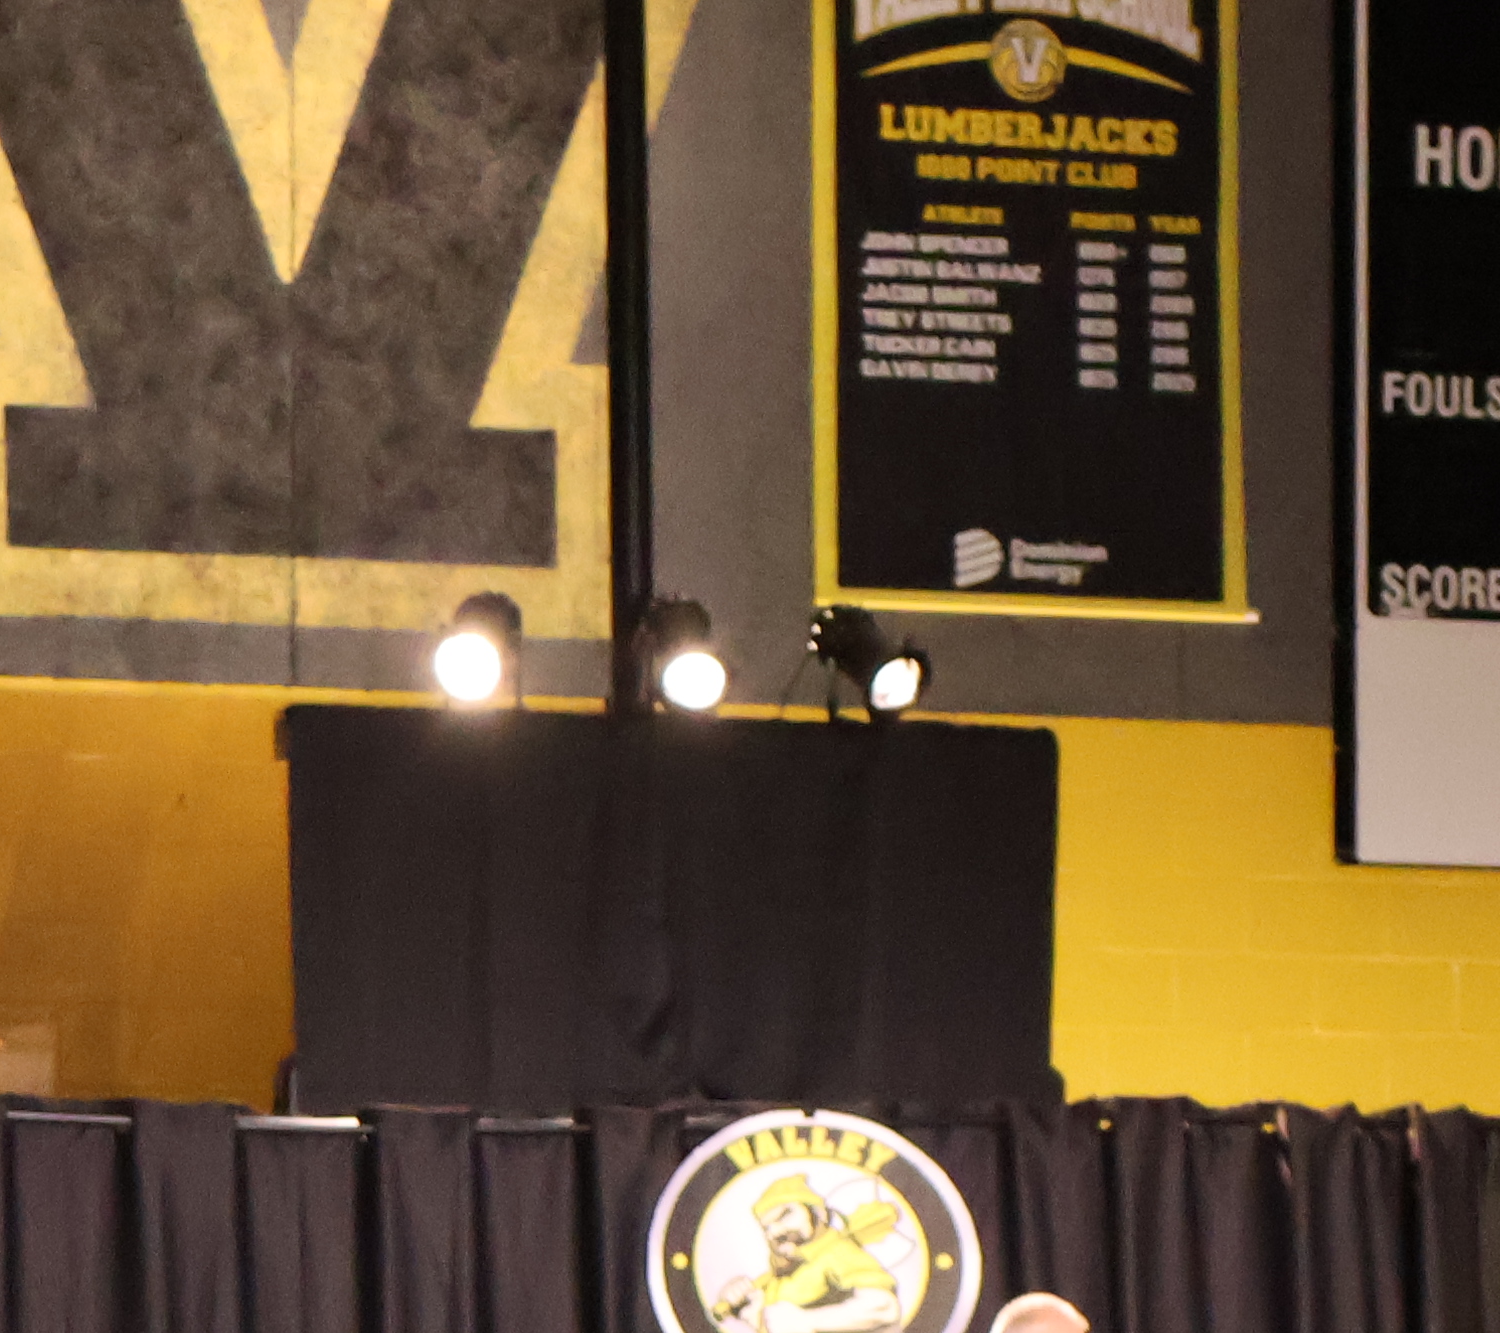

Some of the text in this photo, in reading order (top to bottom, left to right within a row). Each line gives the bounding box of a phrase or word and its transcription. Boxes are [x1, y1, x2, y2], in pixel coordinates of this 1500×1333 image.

[879, 103, 1179, 156] LUMBERJACKS
[976, 156, 1061, 184] POINT
[1066, 161, 1139, 190] CLUB
[723, 1125, 897, 1174] VALLEY
